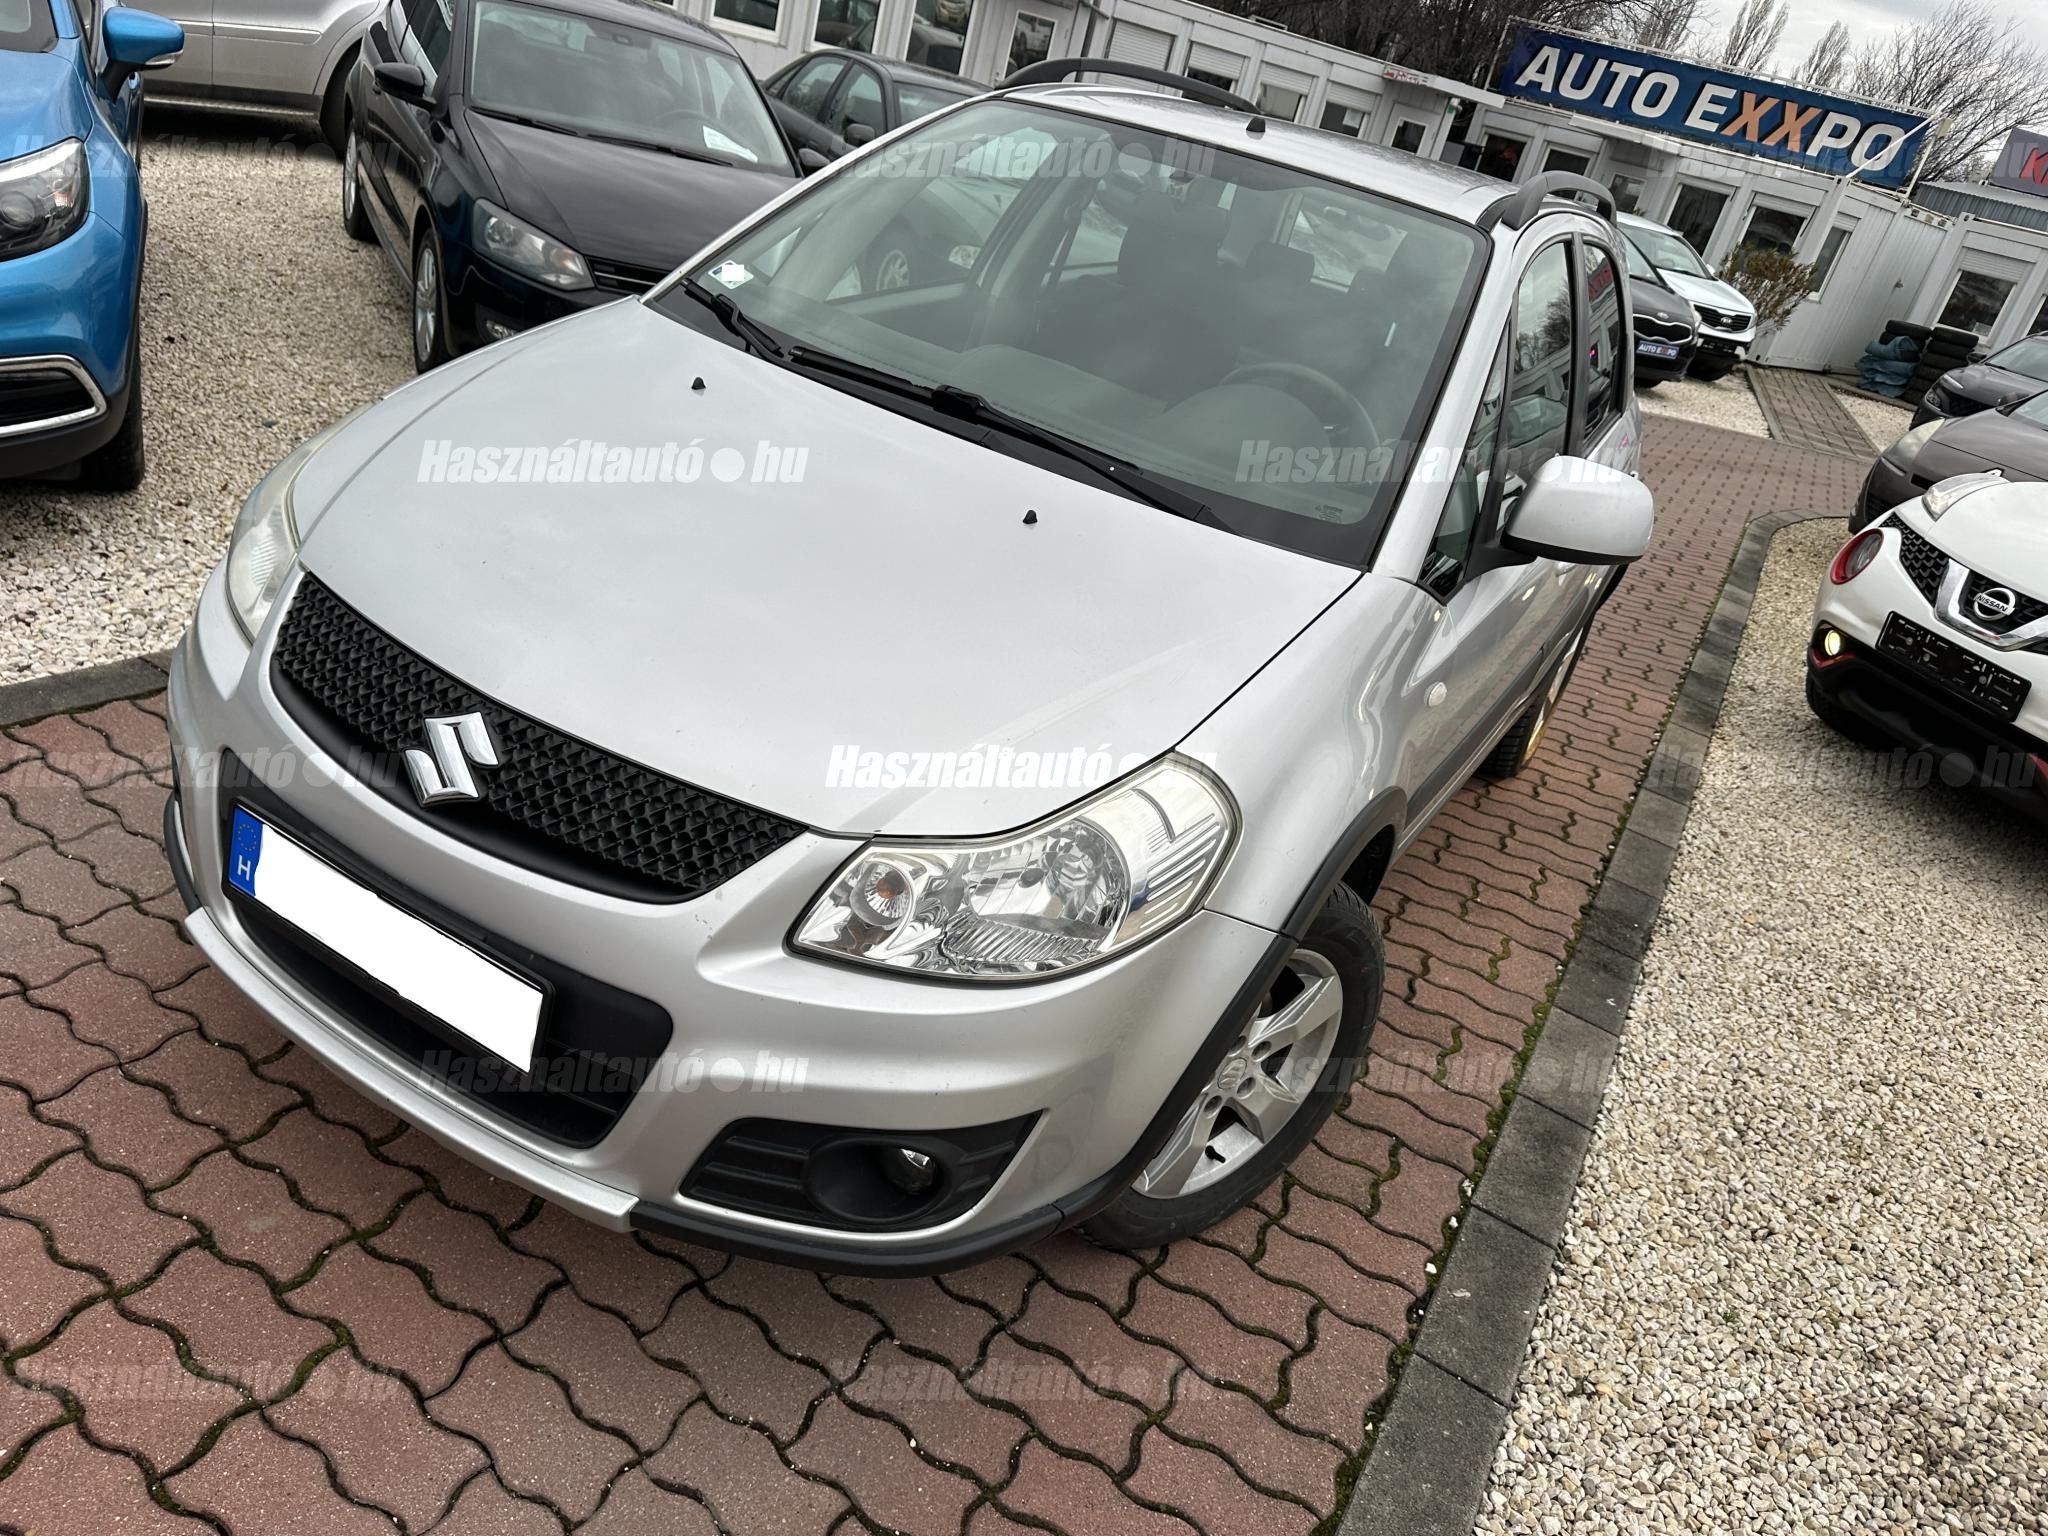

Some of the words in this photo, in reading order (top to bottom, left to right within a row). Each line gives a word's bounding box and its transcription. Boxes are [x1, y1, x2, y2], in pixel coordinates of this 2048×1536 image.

[1516, 46, 1680, 118] AUTO
[1684, 82, 1906, 171] EXXPO
[1638, 343, 1656, 353] AUTO
[1976, 594, 2008, 612] NISSAN
[238, 855, 251, 881] H
